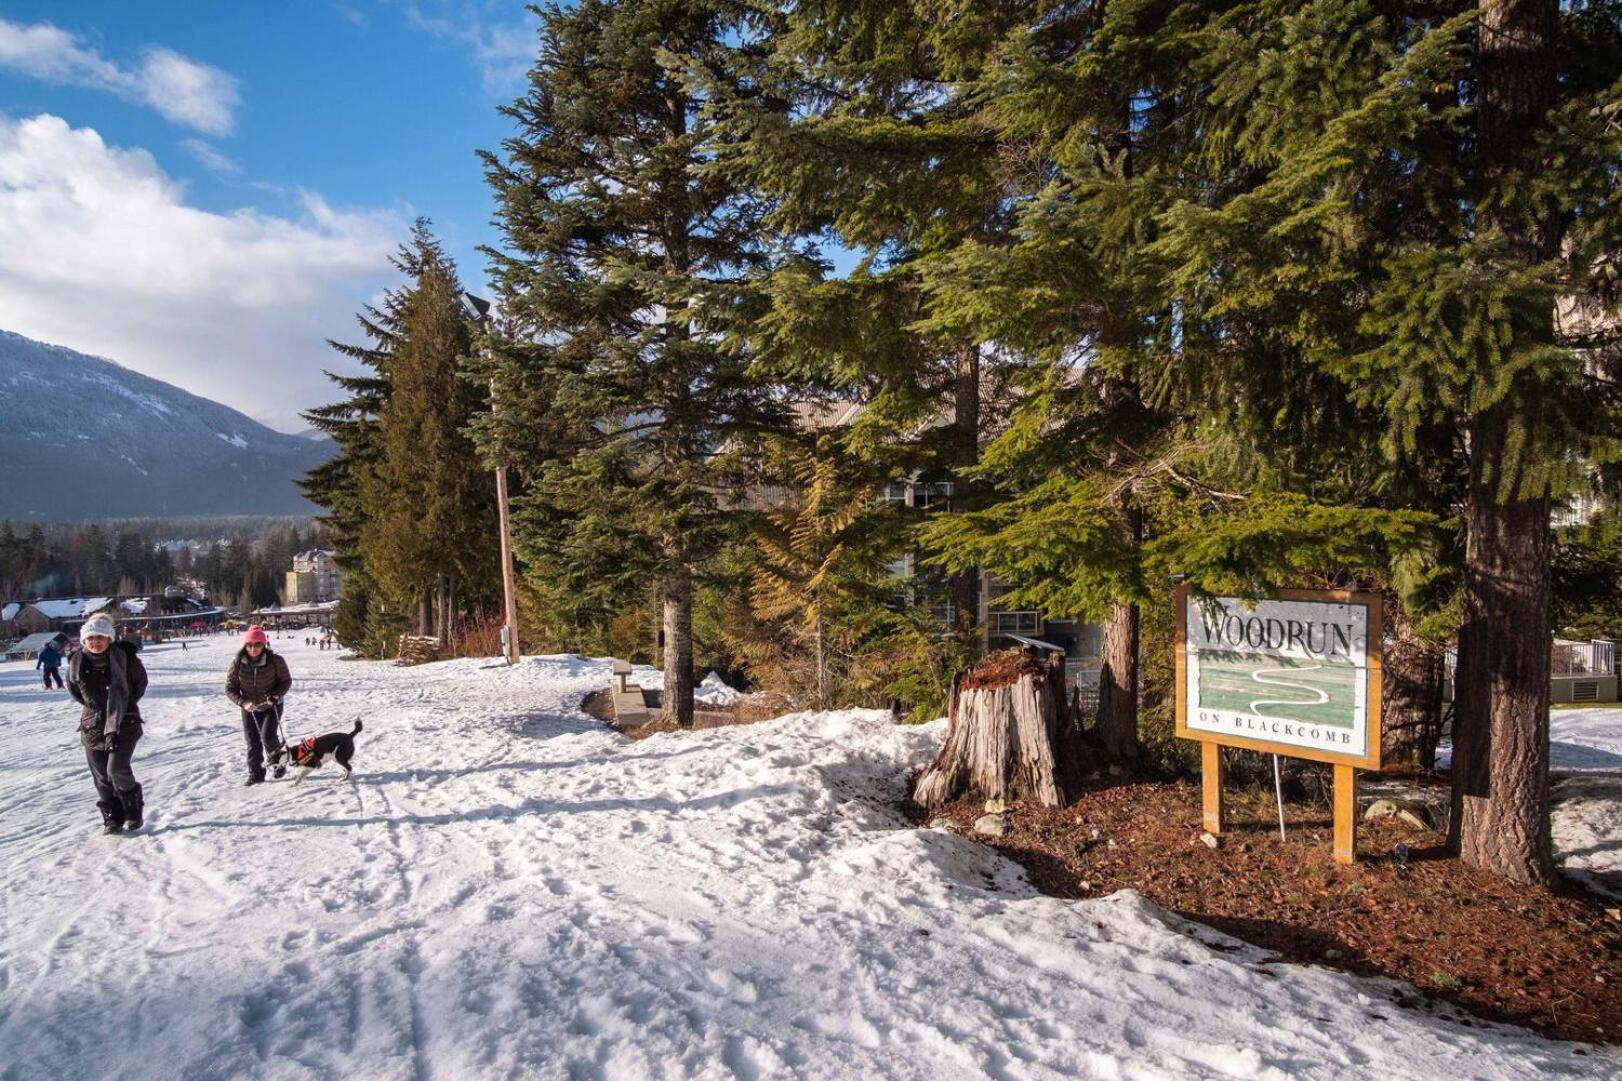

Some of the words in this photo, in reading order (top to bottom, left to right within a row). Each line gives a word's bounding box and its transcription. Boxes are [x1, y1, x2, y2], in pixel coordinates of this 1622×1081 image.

[1201, 605, 1353, 659] WOODRUN
[1199, 711, 1220, 723] ON
[1235, 716, 1351, 744] BLACKCOMB
